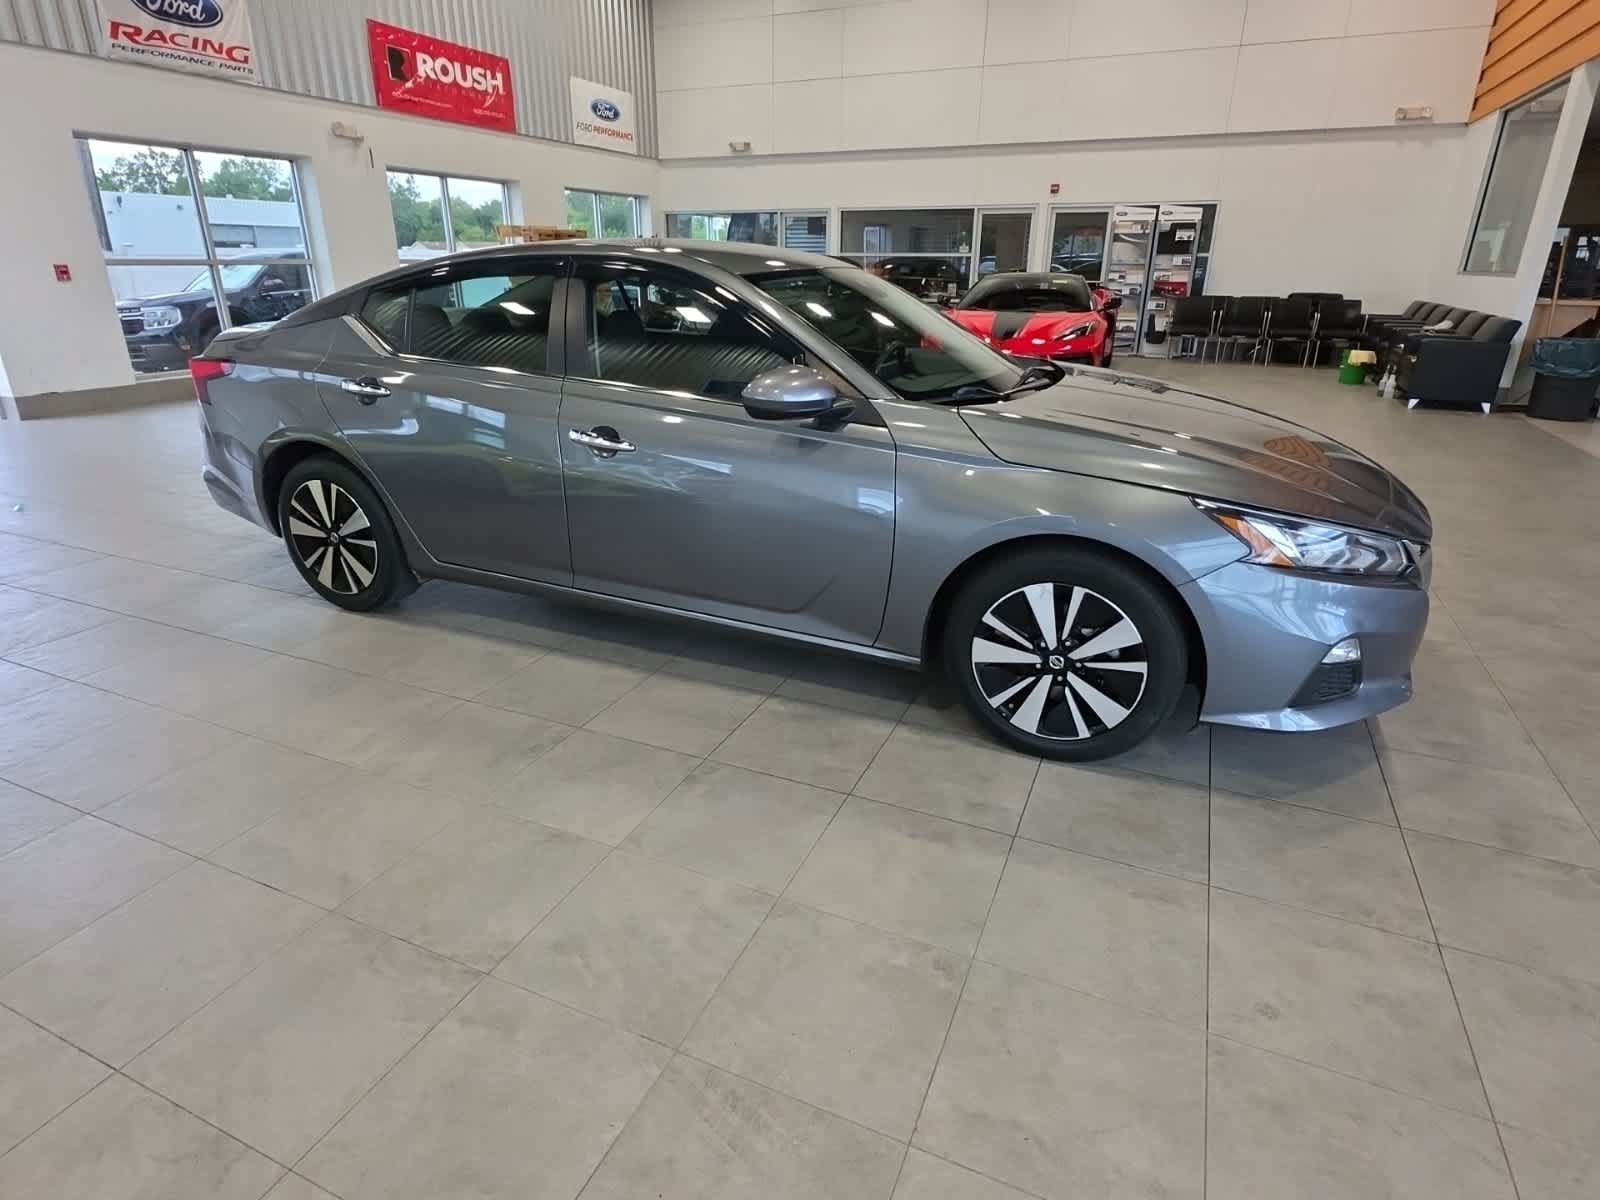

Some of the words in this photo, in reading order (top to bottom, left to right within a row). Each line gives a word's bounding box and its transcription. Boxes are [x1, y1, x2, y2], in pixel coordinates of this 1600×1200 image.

[109, 20, 251, 65] RACING
[111, 43, 216, 68] PERFORMANCE
[218, 62, 254, 75] PARTS
[415, 51, 504, 95] ROUSH
